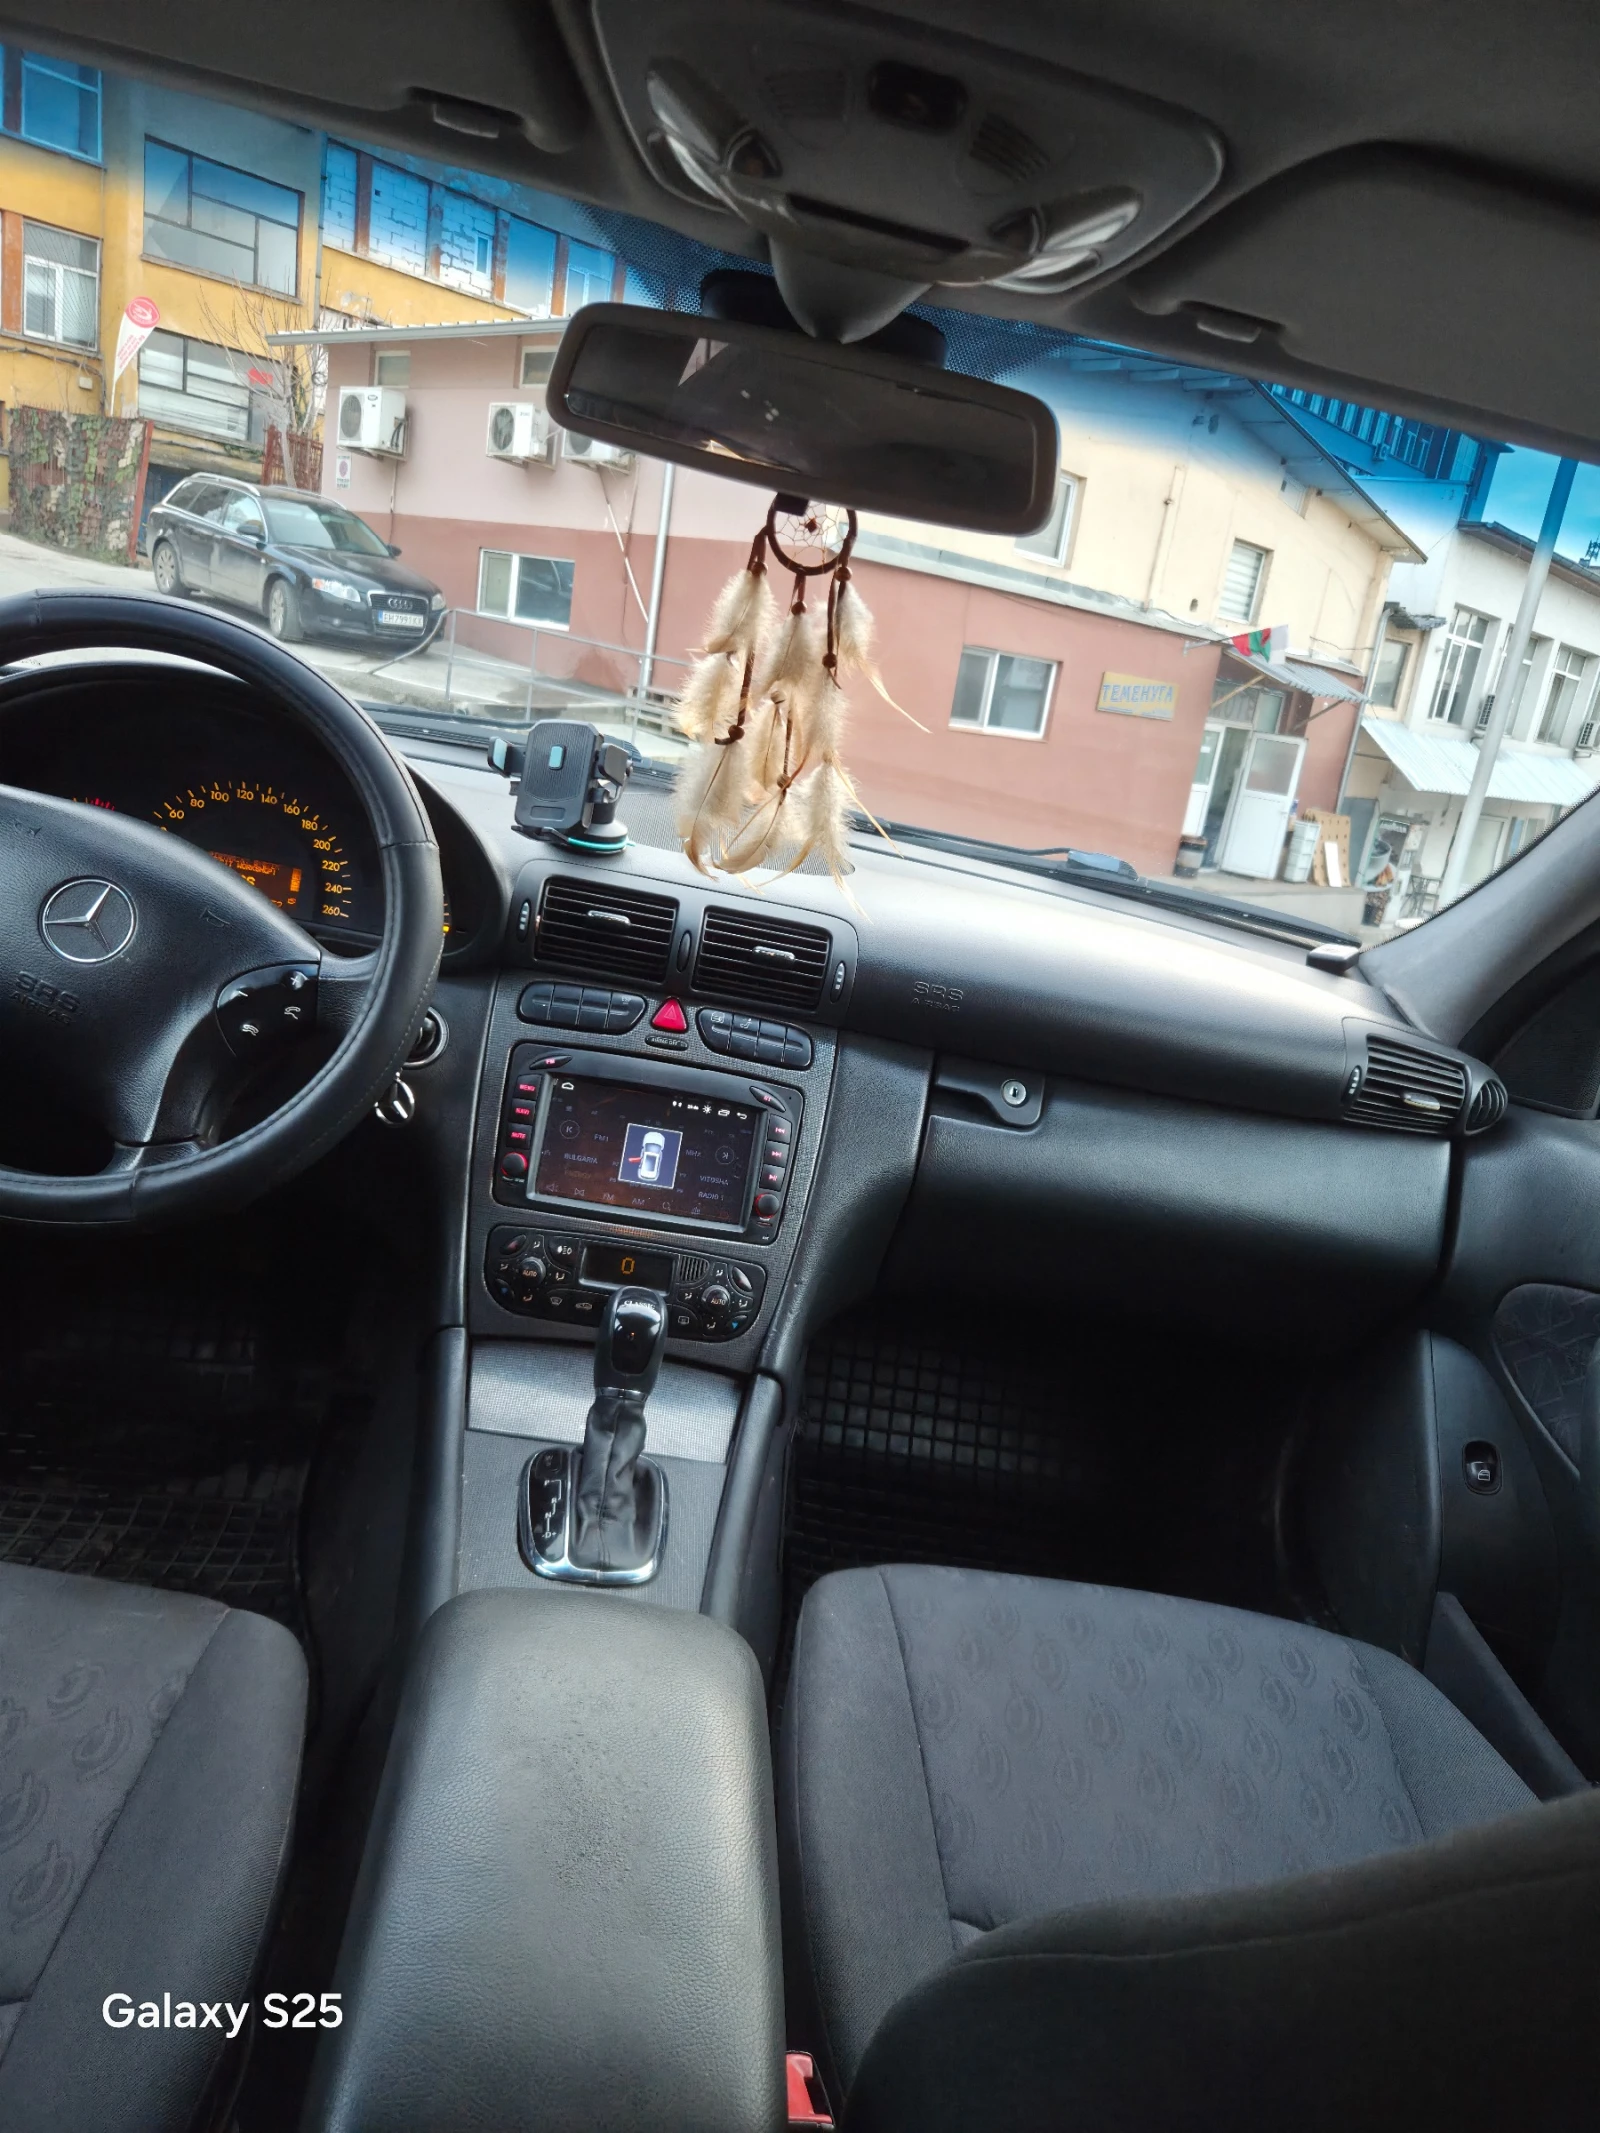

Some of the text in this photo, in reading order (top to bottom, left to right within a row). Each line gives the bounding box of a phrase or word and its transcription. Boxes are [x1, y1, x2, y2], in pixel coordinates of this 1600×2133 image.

[210, 790, 229, 802] 100
[236, 789, 254, 801] 120
[261, 793, 278, 805] 140
[190, 798, 205, 809] 80
[283, 803, 301, 816] 160
[169, 808, 185, 820] 60
[301, 819, 319, 831] 180
[313, 839, 331, 851] 200
[321, 859, 341, 872] 220
[324, 882, 343, 894] 240
[322, 904, 341, 917] 260
